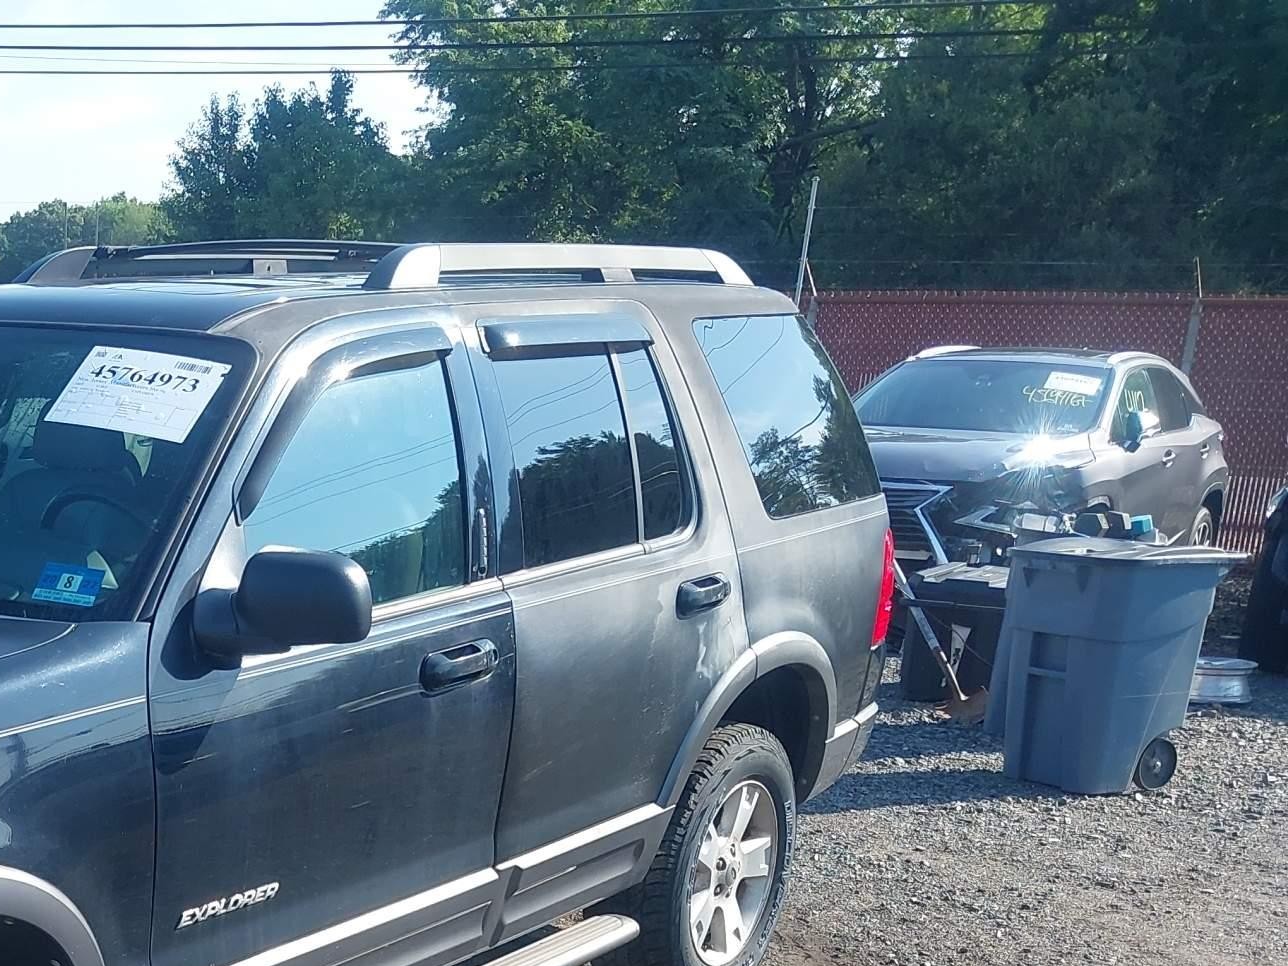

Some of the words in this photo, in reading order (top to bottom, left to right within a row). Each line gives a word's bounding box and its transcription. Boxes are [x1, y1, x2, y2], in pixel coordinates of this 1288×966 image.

[90, 364, 200, 393] 45764973
[64, 576, 74, 588] 8
[176, 881, 280, 929] EXPLORER
